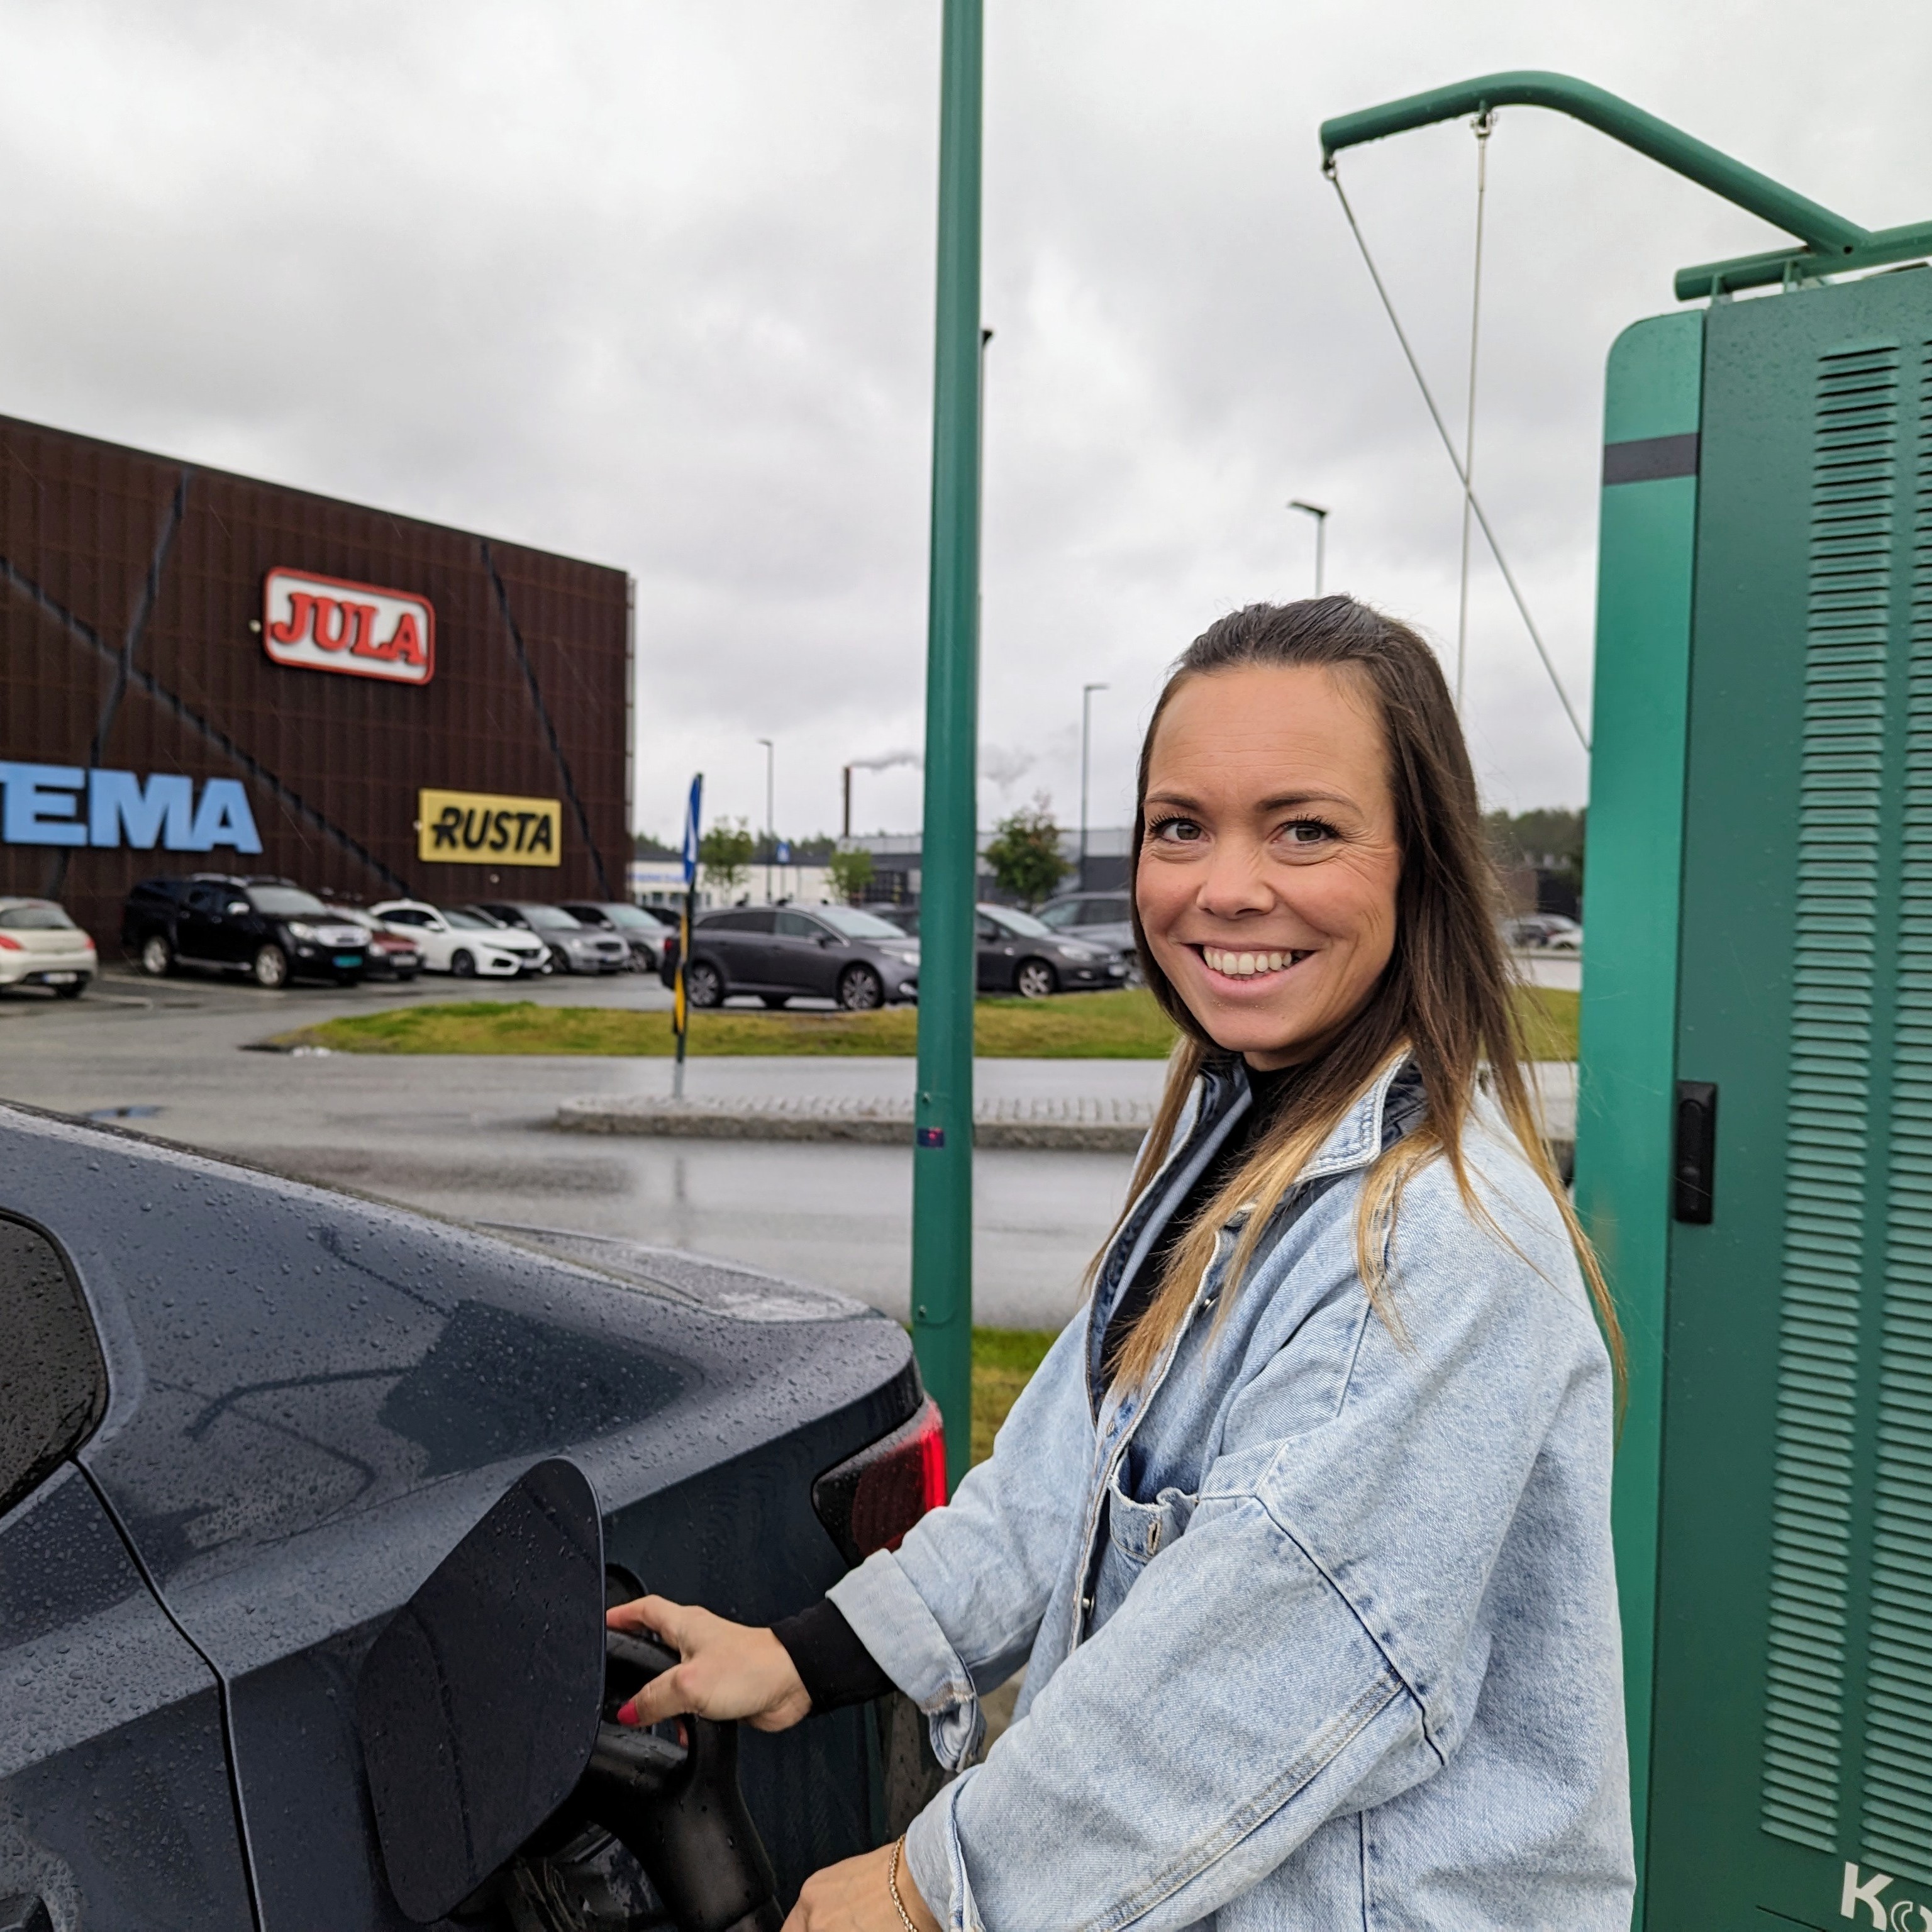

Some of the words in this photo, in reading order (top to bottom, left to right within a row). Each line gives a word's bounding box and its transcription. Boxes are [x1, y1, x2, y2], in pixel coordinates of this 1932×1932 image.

[271, 592, 426, 665] JULA
[0, 761, 263, 854] EMA
[431, 806, 553, 853] RUSTA
